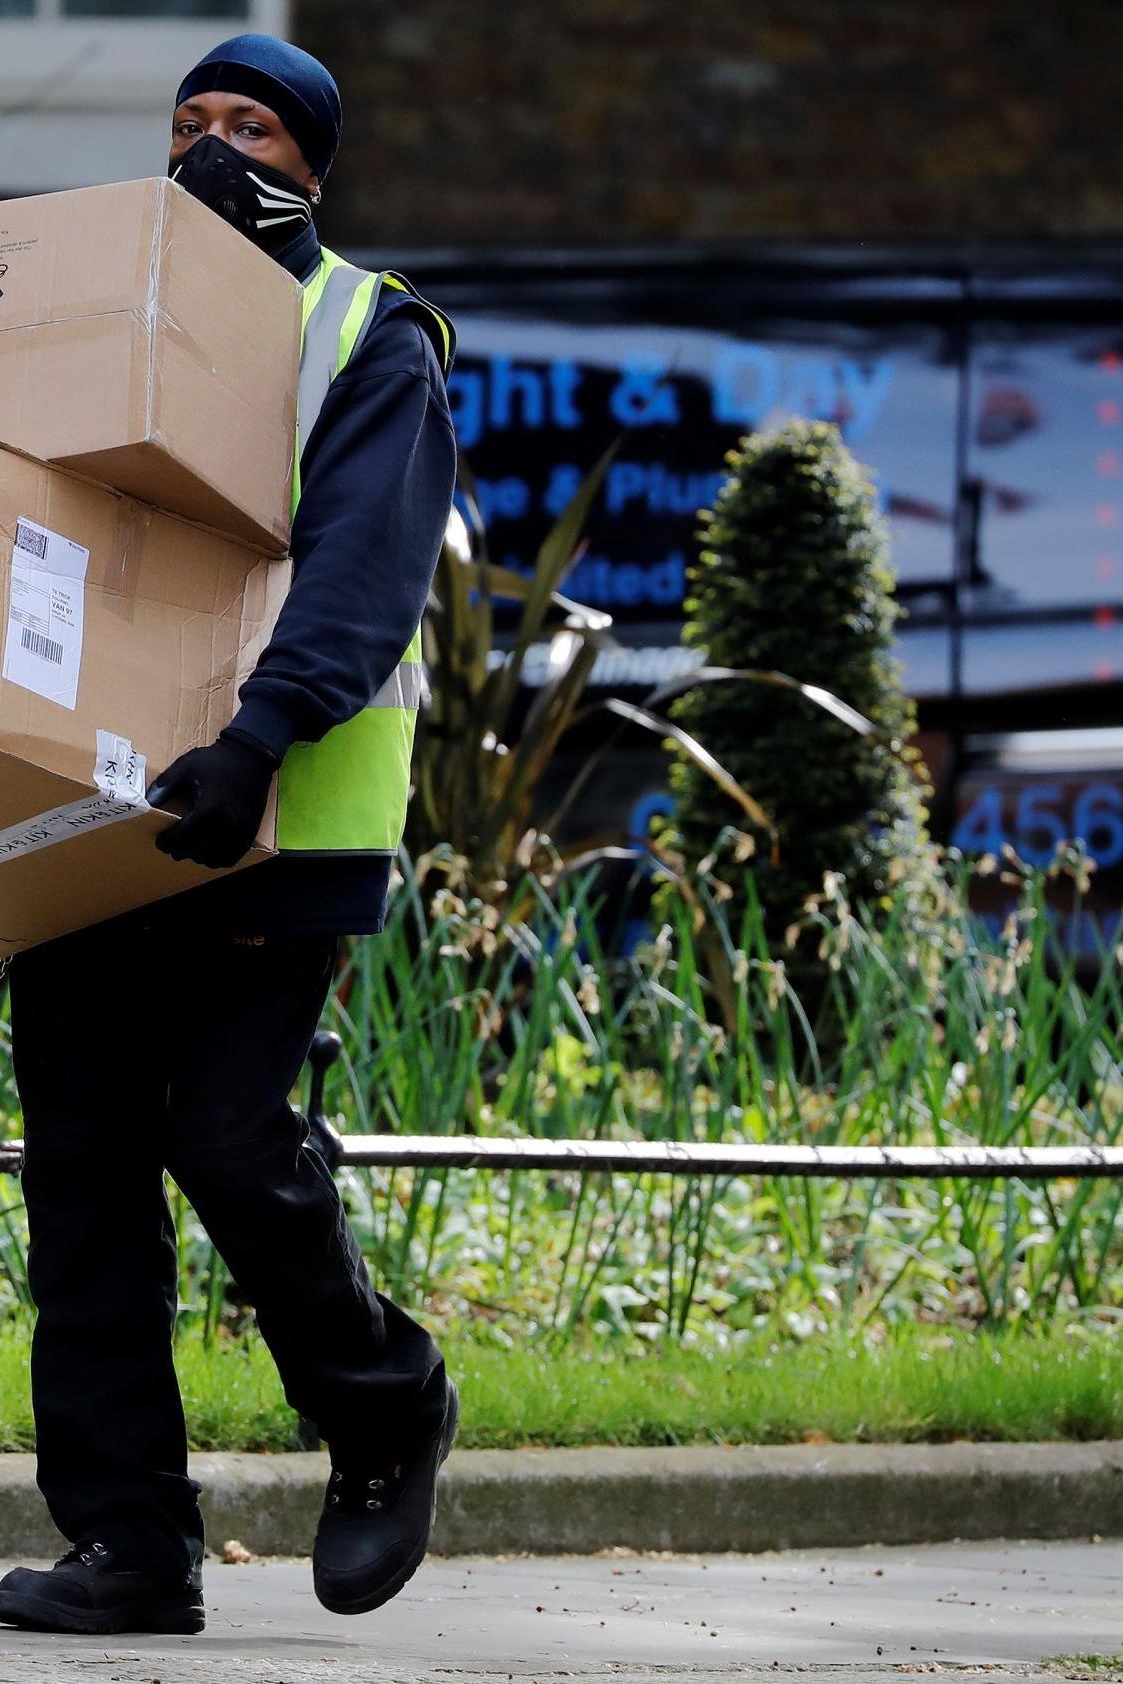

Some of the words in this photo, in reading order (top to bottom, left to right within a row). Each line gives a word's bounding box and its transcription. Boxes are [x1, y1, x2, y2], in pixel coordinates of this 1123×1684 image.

[448, 354, 582, 449] ght
[611, 350, 680, 427] &
[712, 345, 896, 442] Day
